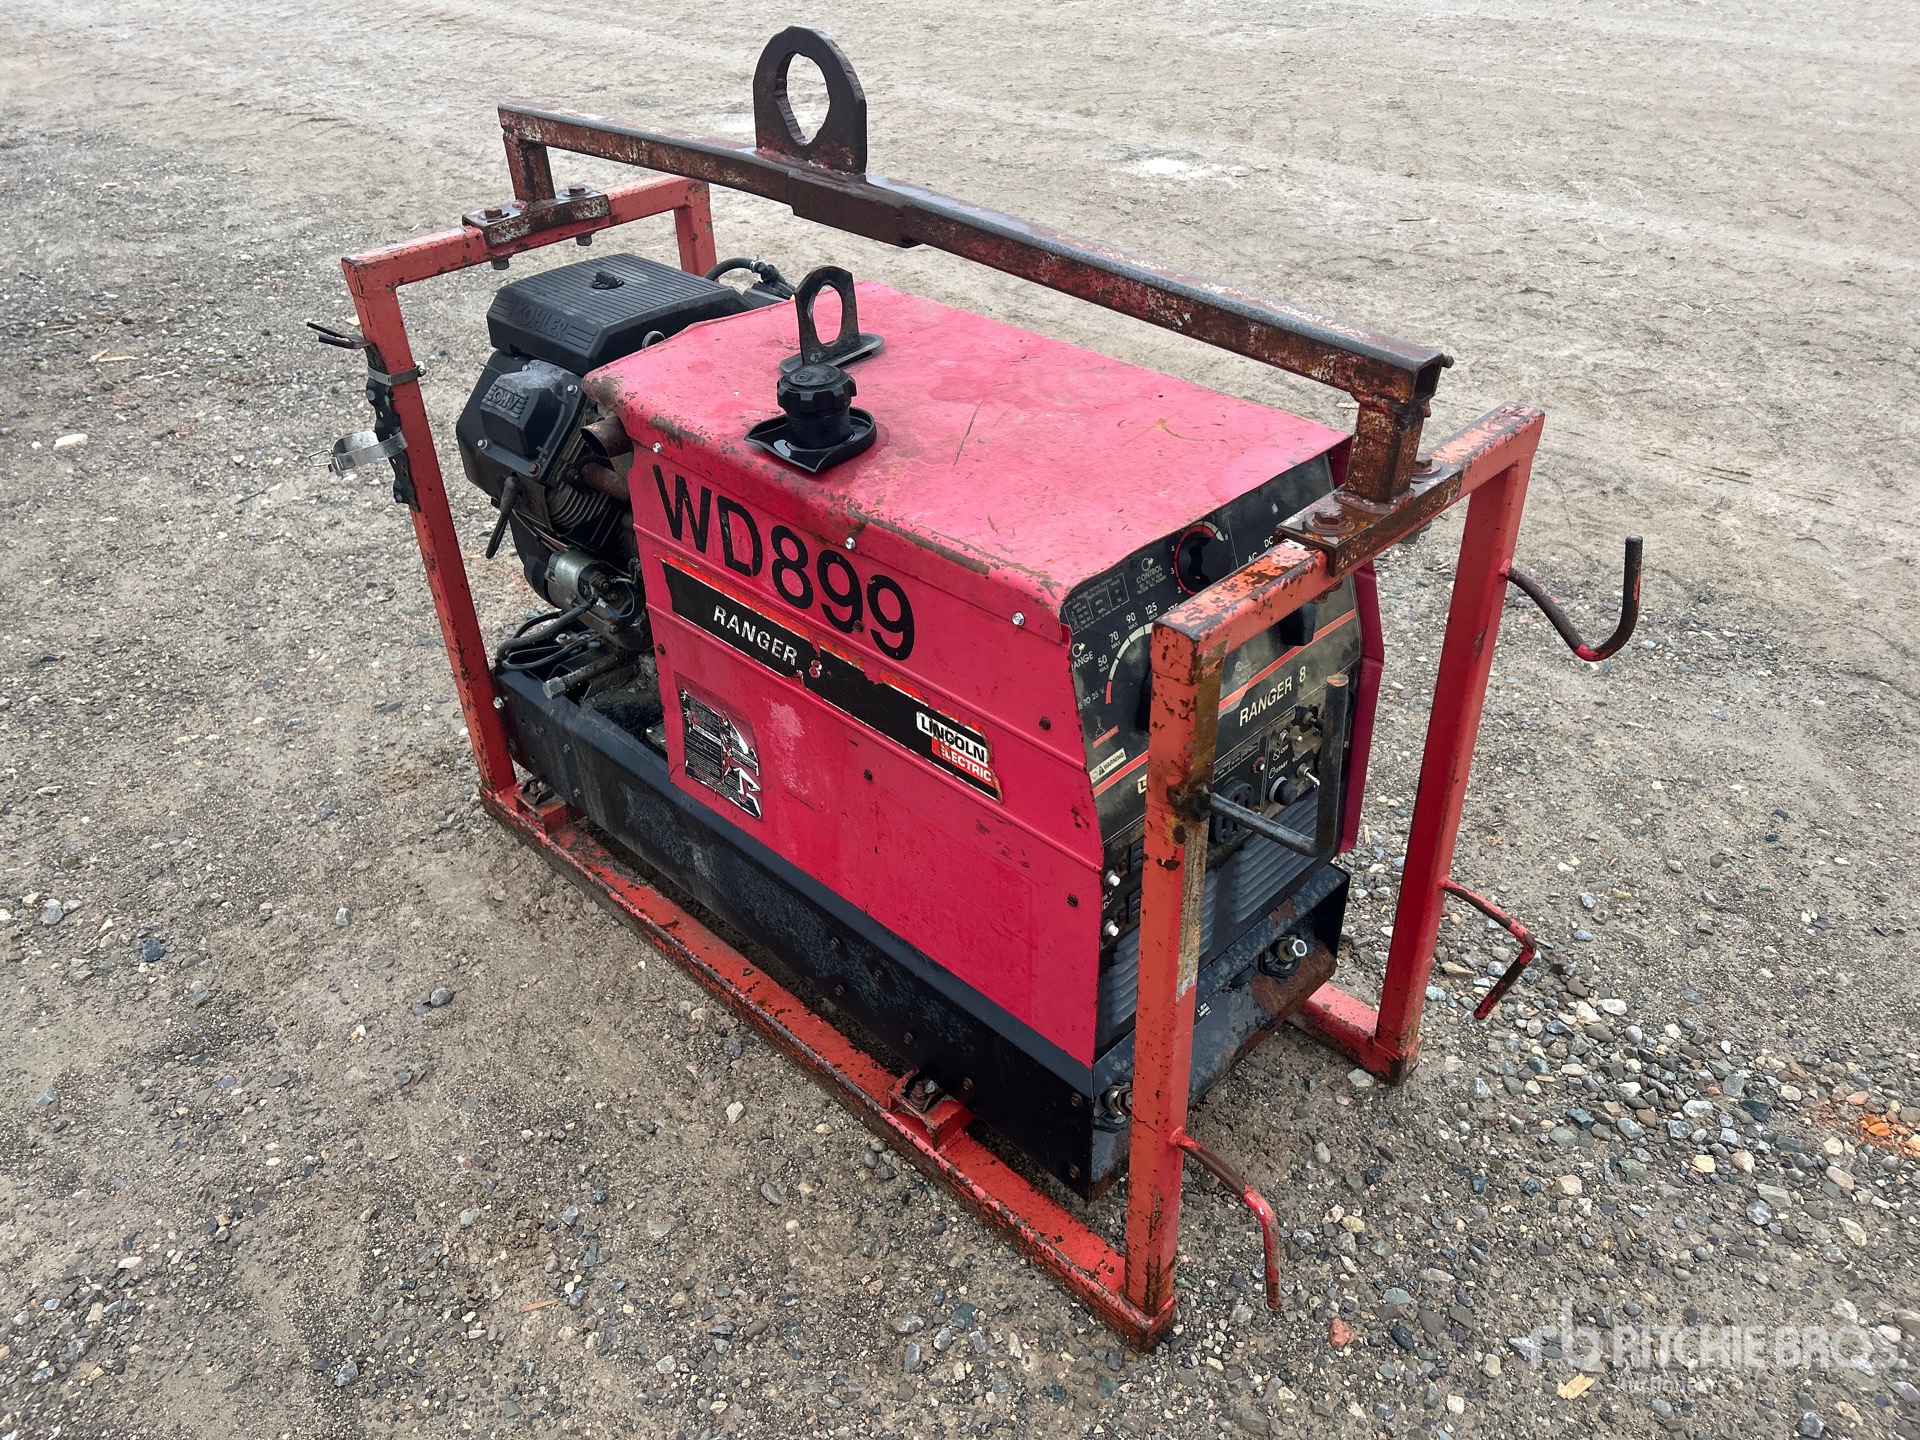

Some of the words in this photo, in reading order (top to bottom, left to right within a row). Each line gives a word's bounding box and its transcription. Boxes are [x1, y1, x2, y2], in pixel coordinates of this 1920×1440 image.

[510, 300, 569, 341] KOHLER
[1264, 536, 1274, 548] DC
[652, 464, 915, 661] WD899
[1136, 564, 1164, 584] CONTROL
[1145, 602, 1158, 615] 125
[1126, 612, 1136, 624] 90
[1128, 621, 1138, 631] MAX
[713, 605, 798, 666] RANGER
[809, 659, 823, 679] 8
[1109, 630, 1119, 644] 70
[1111, 640, 1121, 650] MAX
[1072, 651, 1094, 671] ANGE
[1097, 654, 1108, 667] 50
[1099, 664, 1109, 673] MAX
[1239, 675, 1293, 727] RANGER
[1299, 665, 1307, 683] 8
[921, 716, 986, 764] LINCOLN
[940, 745, 992, 782] ELECTRIC
